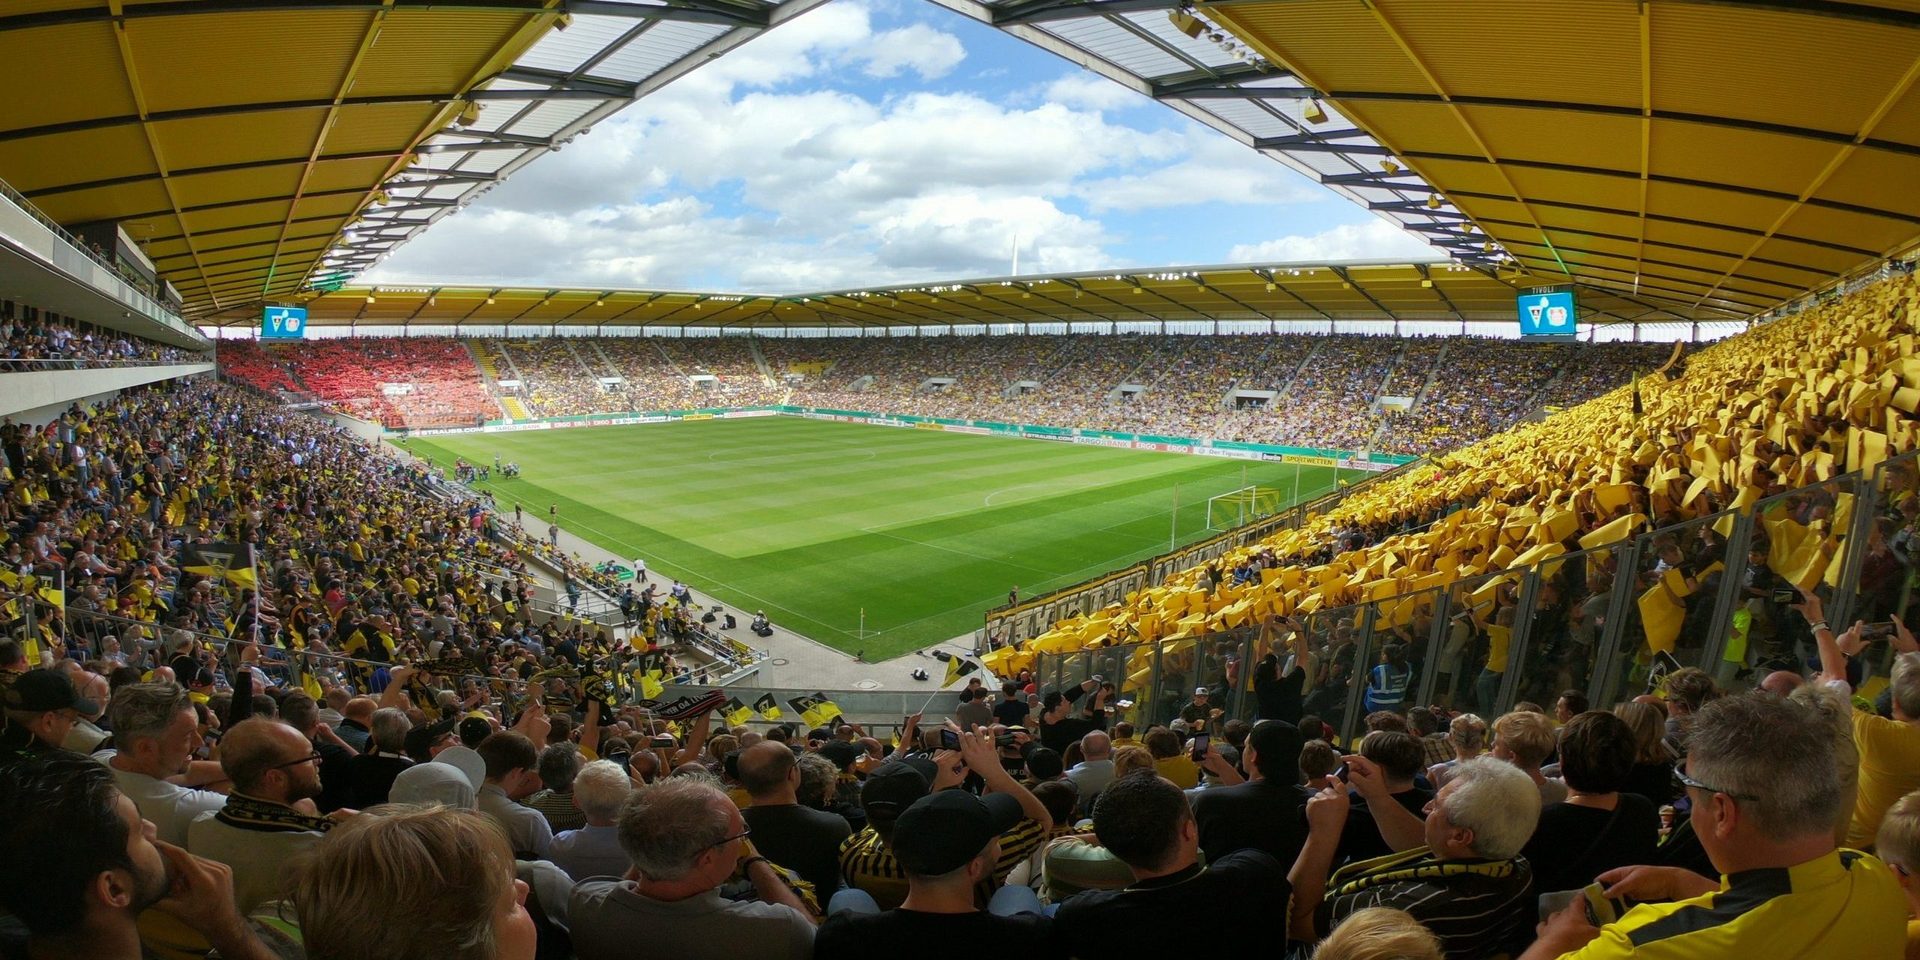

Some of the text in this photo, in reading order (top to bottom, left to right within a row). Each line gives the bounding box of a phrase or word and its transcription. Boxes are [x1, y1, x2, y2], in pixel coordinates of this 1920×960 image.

[1532, 286, 1554, 294] TIVOLI
[1136, 442, 1157, 450] ERGO
[1168, 445, 1189, 453] ERGO
[1285, 455, 1332, 465] SPORTWETTEN
